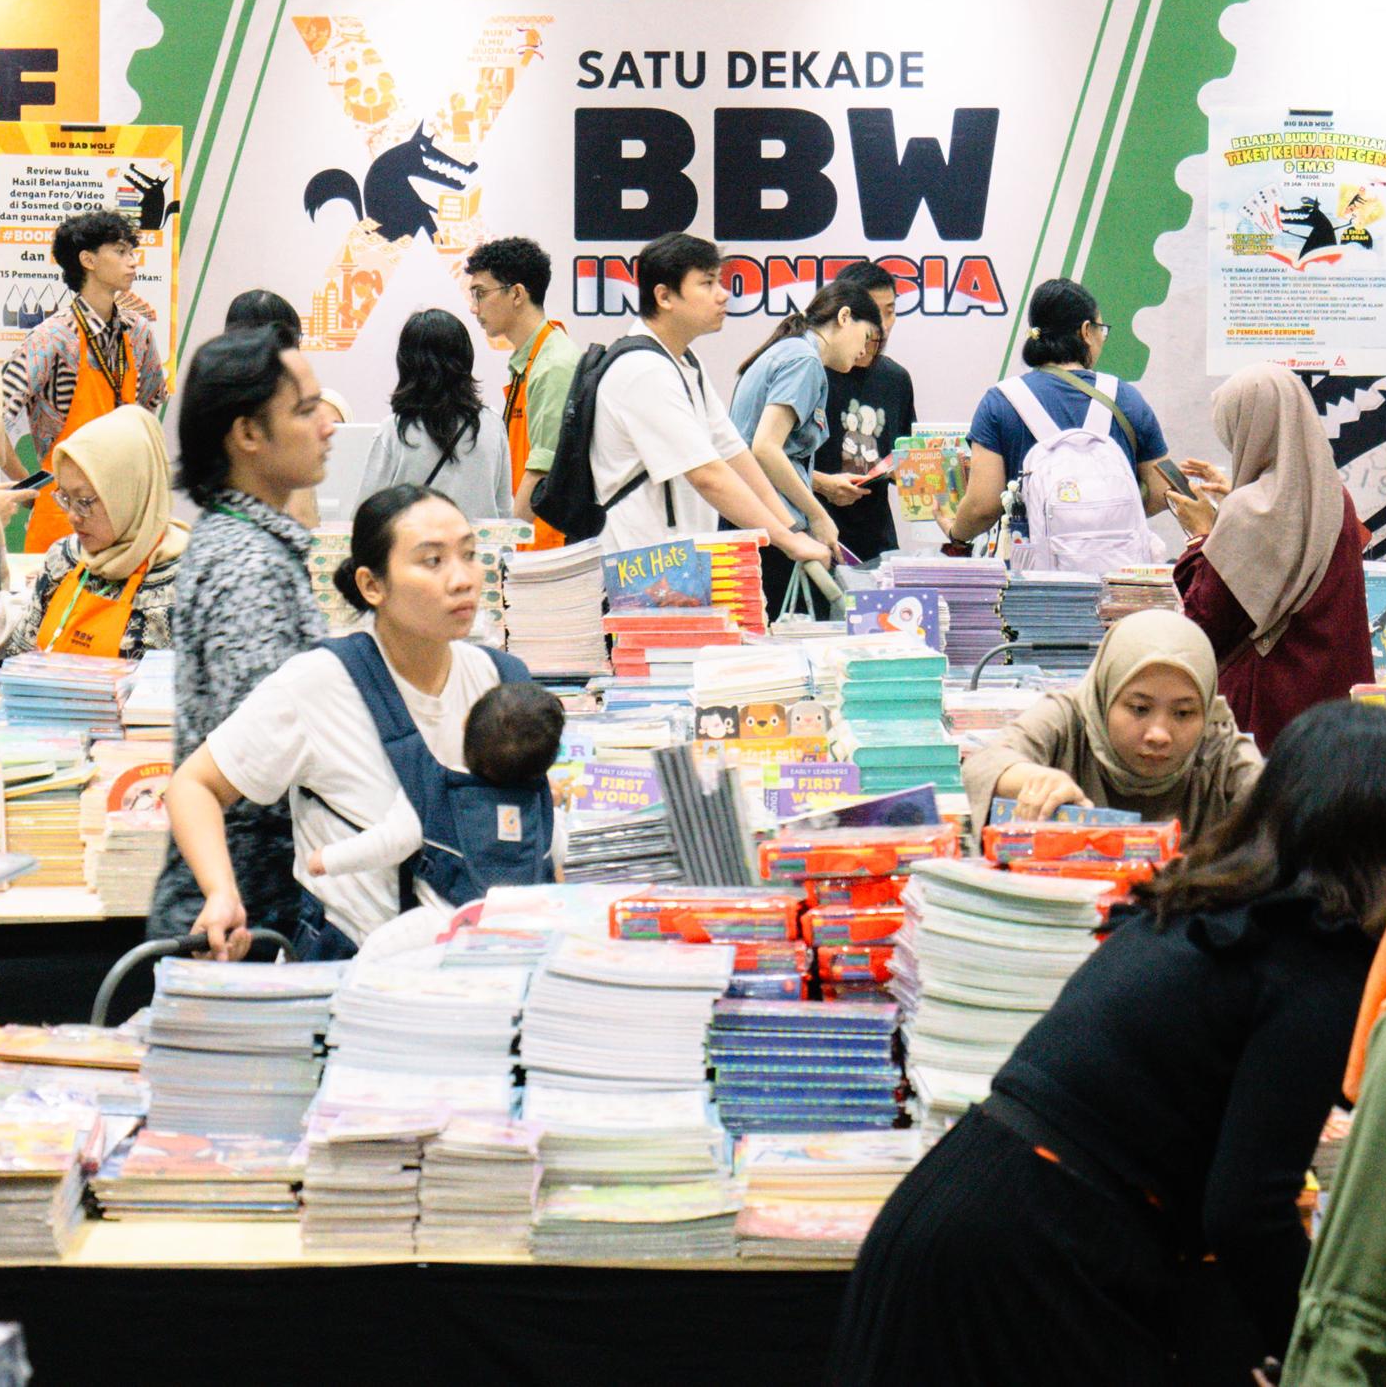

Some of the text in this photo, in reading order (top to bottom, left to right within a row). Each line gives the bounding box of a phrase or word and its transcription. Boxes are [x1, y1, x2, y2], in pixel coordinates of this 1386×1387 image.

[577, 50, 925, 90] SATU DEKADE
[1232, 135, 1282, 150] BELANJA
[1284, 133, 1317, 144] BUKU
[1224, 146, 1271, 166] TIKET
[1272, 146, 1293, 159] KE
[1294, 145, 1334, 159] LUAR
[27, 167, 89, 176] Review Buku
[1296, 161, 1334, 173] EMAS
[574, 107, 1000, 242] BBW
[13, 178, 103, 188] Hasil Belanjaanmu
[10, 190, 105, 200] dengan Foto/Video
[22, 202, 59, 210] Sosmed
[0, 213, 18, 221] dan
[20, 214, 62, 222] gunakan
[21, 252, 45, 262] dan
[0, 270, 59, 281] 15 Pemenang
[618, 546, 687, 588] Kat Hats
[600, 777, 646, 791] FIRST
[798, 777, 842, 790] FIRST
[592, 790, 650, 805] WORDS
